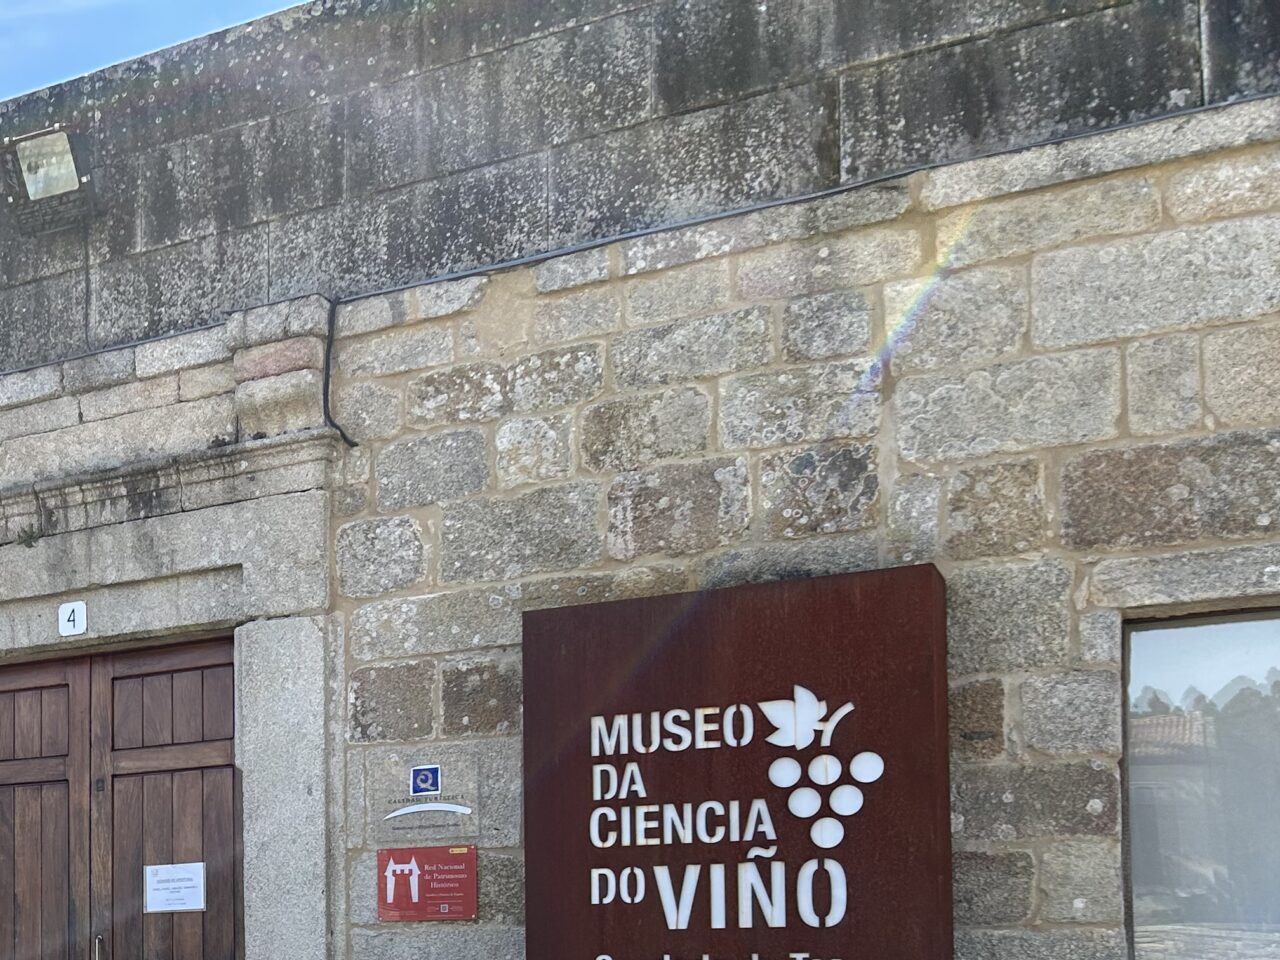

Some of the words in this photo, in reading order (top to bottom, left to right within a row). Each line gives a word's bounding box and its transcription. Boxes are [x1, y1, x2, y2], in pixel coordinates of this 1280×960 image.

[67, 608, 76, 629] 4
[590, 703, 755, 757] MUSEO
[592, 762, 647, 801] DA
[589, 798, 778, 848] CIENCIA
[590, 866, 646, 905] DO
[653, 845, 848, 930] VIÑO
